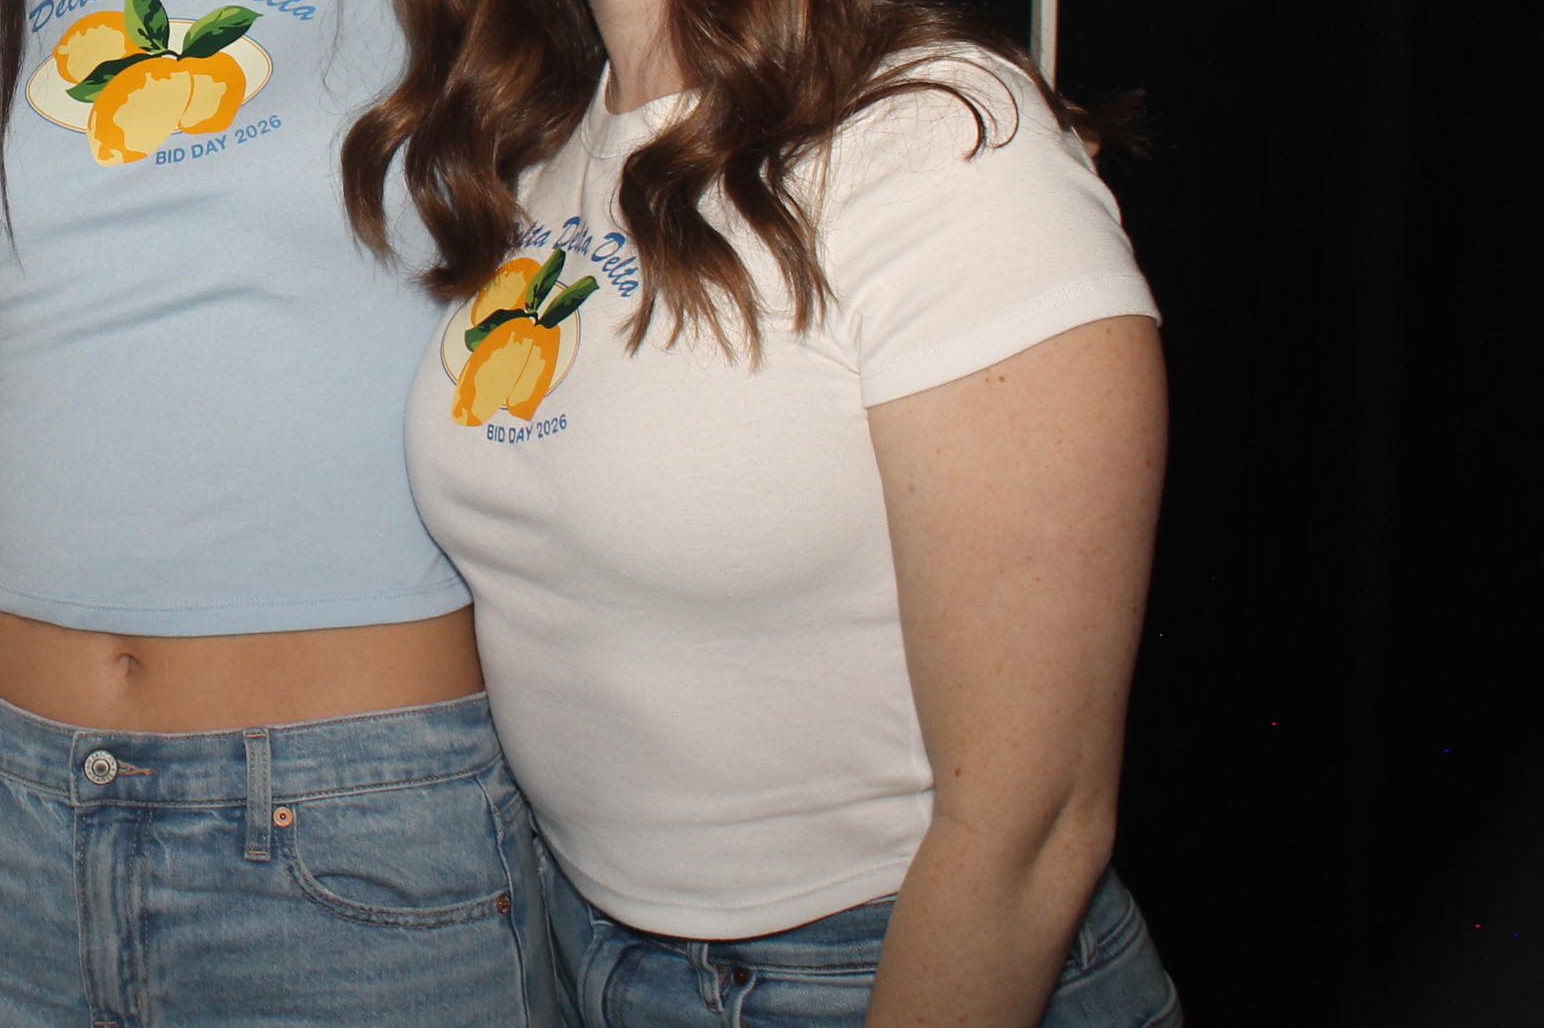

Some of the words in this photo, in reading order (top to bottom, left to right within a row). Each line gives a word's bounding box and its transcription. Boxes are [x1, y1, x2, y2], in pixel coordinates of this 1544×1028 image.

[155, 148, 186, 165] BID
[191, 135, 227, 159] DAY
[234, 115, 282, 144] 2026
[552, 216, 594, 257] Delta
[591, 232, 639, 297] Delta
[486, 424, 506, 443] BID
[508, 425, 533, 444] DAY
[536, 413, 567, 439] 2026
